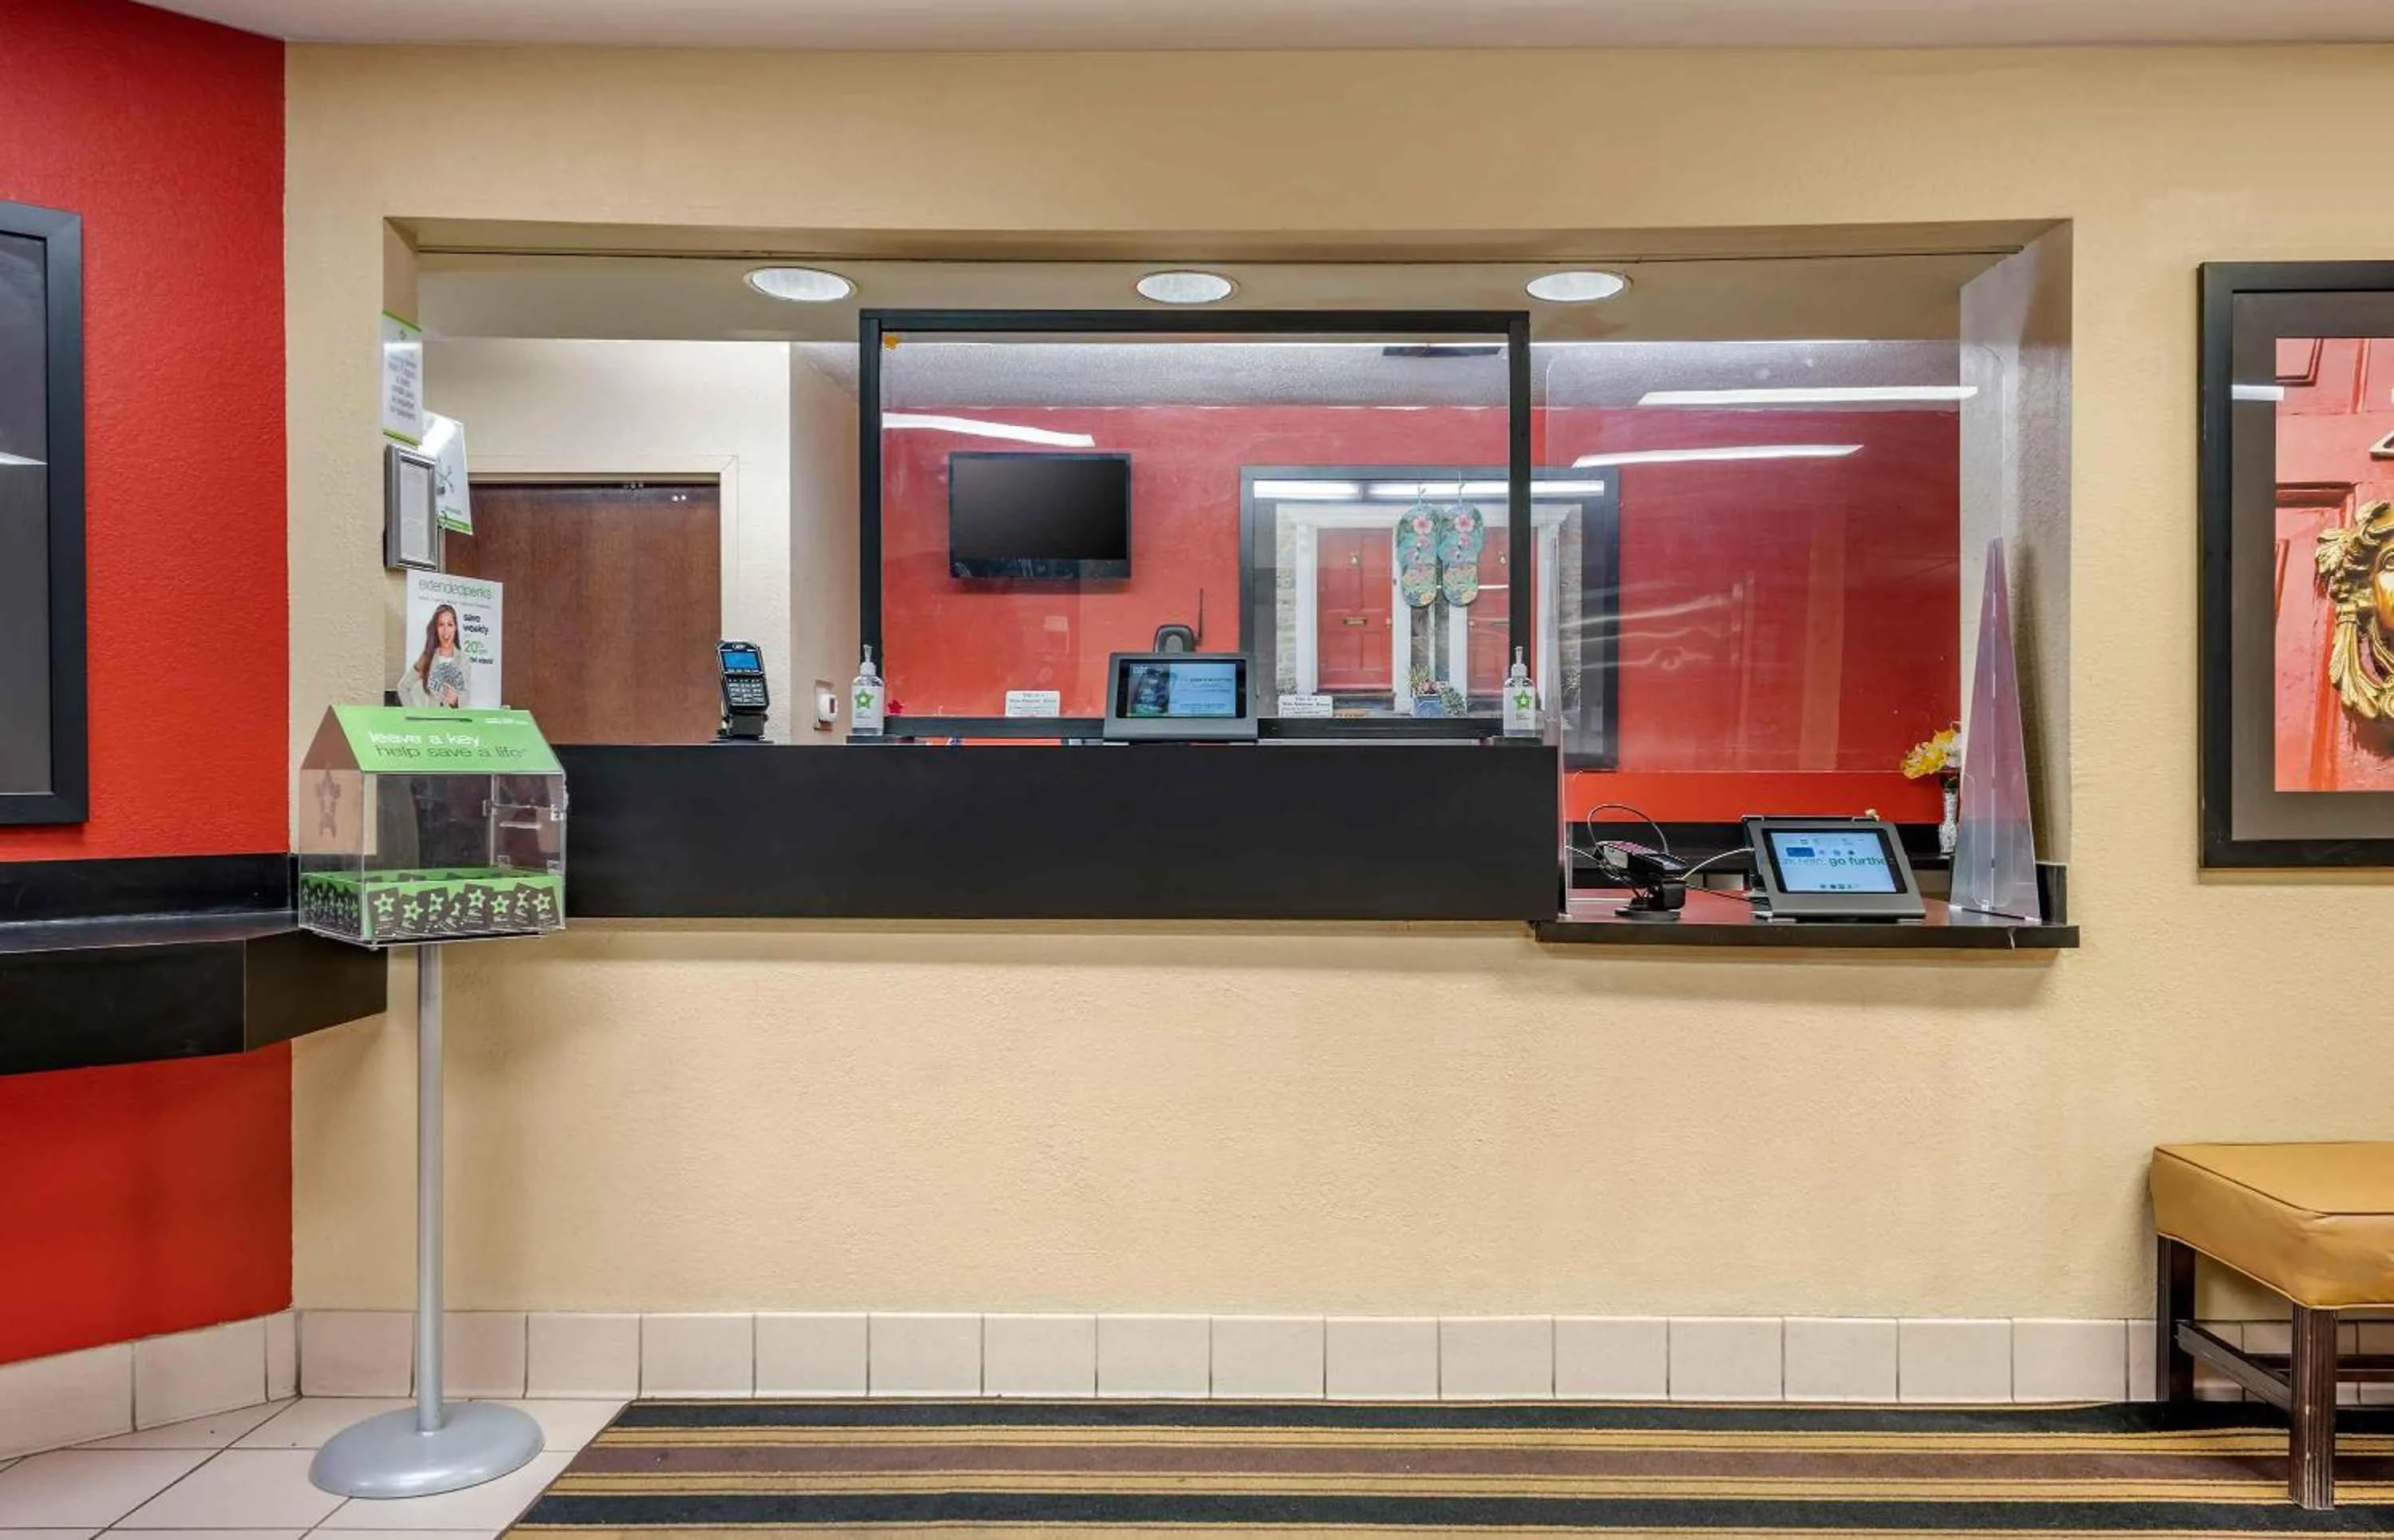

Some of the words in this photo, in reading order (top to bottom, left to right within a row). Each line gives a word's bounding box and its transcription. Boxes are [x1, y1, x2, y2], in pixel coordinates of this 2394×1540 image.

[418, 579, 492, 600] extendedperks
[463, 625, 488, 636] weekly
[369, 731, 422, 744] leave
[428, 735, 444, 744] a
[446, 733, 480, 747] key
[375, 744, 421, 758] help
[427, 748, 472, 757] save
[478, 748, 491, 757] a
[1829, 858, 1846, 867] go
